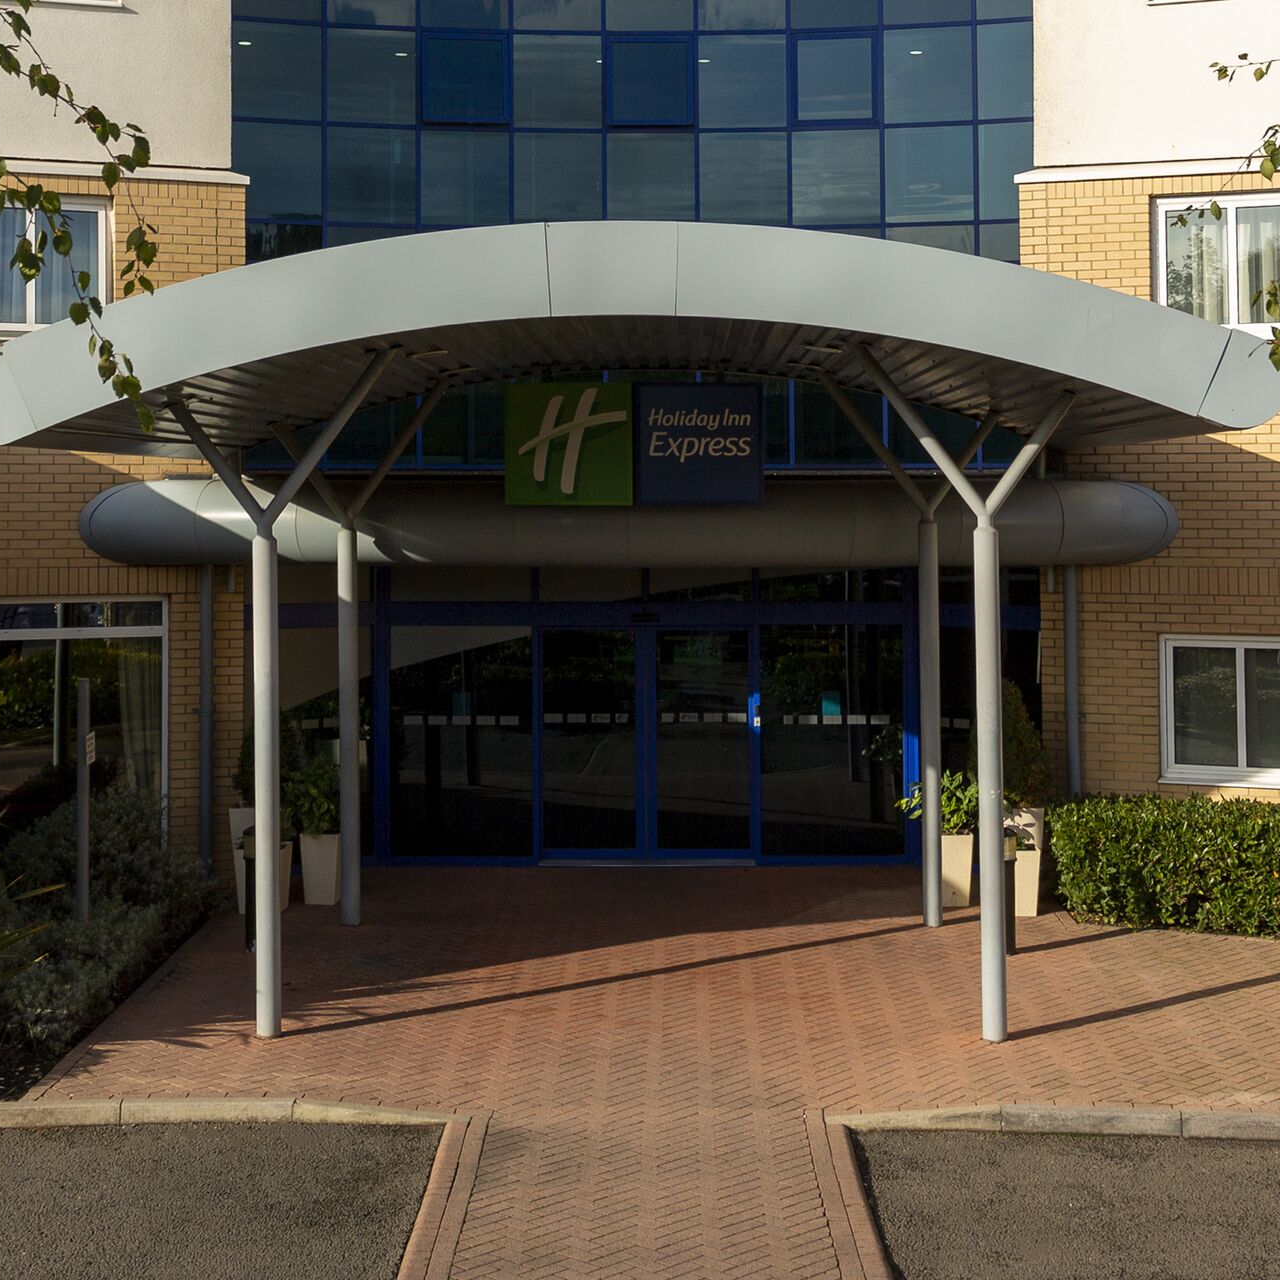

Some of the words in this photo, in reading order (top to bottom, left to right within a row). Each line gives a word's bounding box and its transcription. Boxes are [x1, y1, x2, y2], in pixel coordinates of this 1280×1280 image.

[648, 408, 720, 430] Holiday
[723, 408, 751, 426] Inn
[519, 388, 627, 495] H
[648, 431, 752, 463] Express
